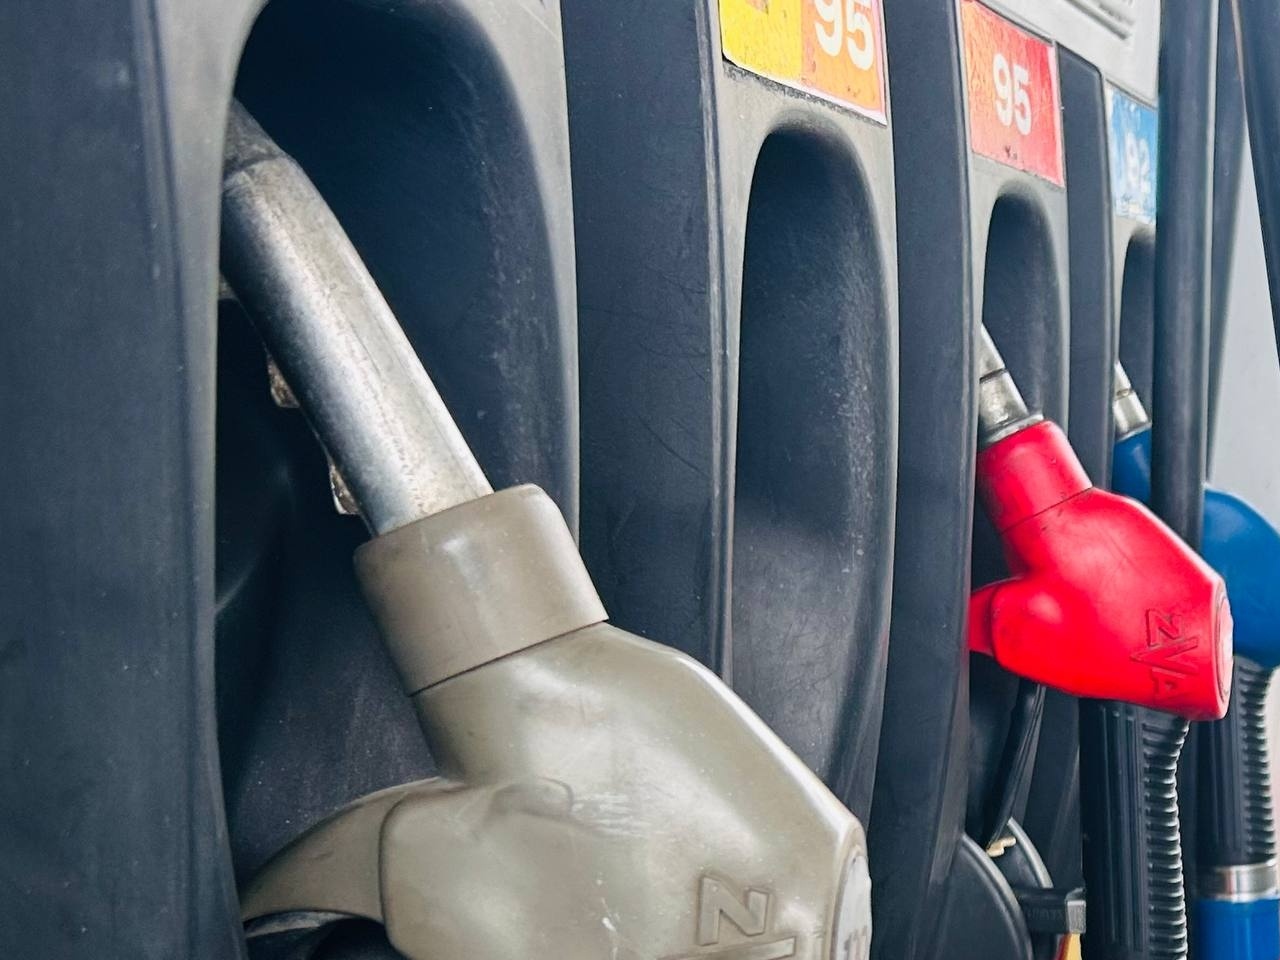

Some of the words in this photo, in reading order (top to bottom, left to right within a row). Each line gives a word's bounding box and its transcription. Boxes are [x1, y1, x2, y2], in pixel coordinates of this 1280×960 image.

[815, 0, 874, 71] 95
[992, 53, 1031, 135] 95
[1130, 608, 1199, 699] ZVA
